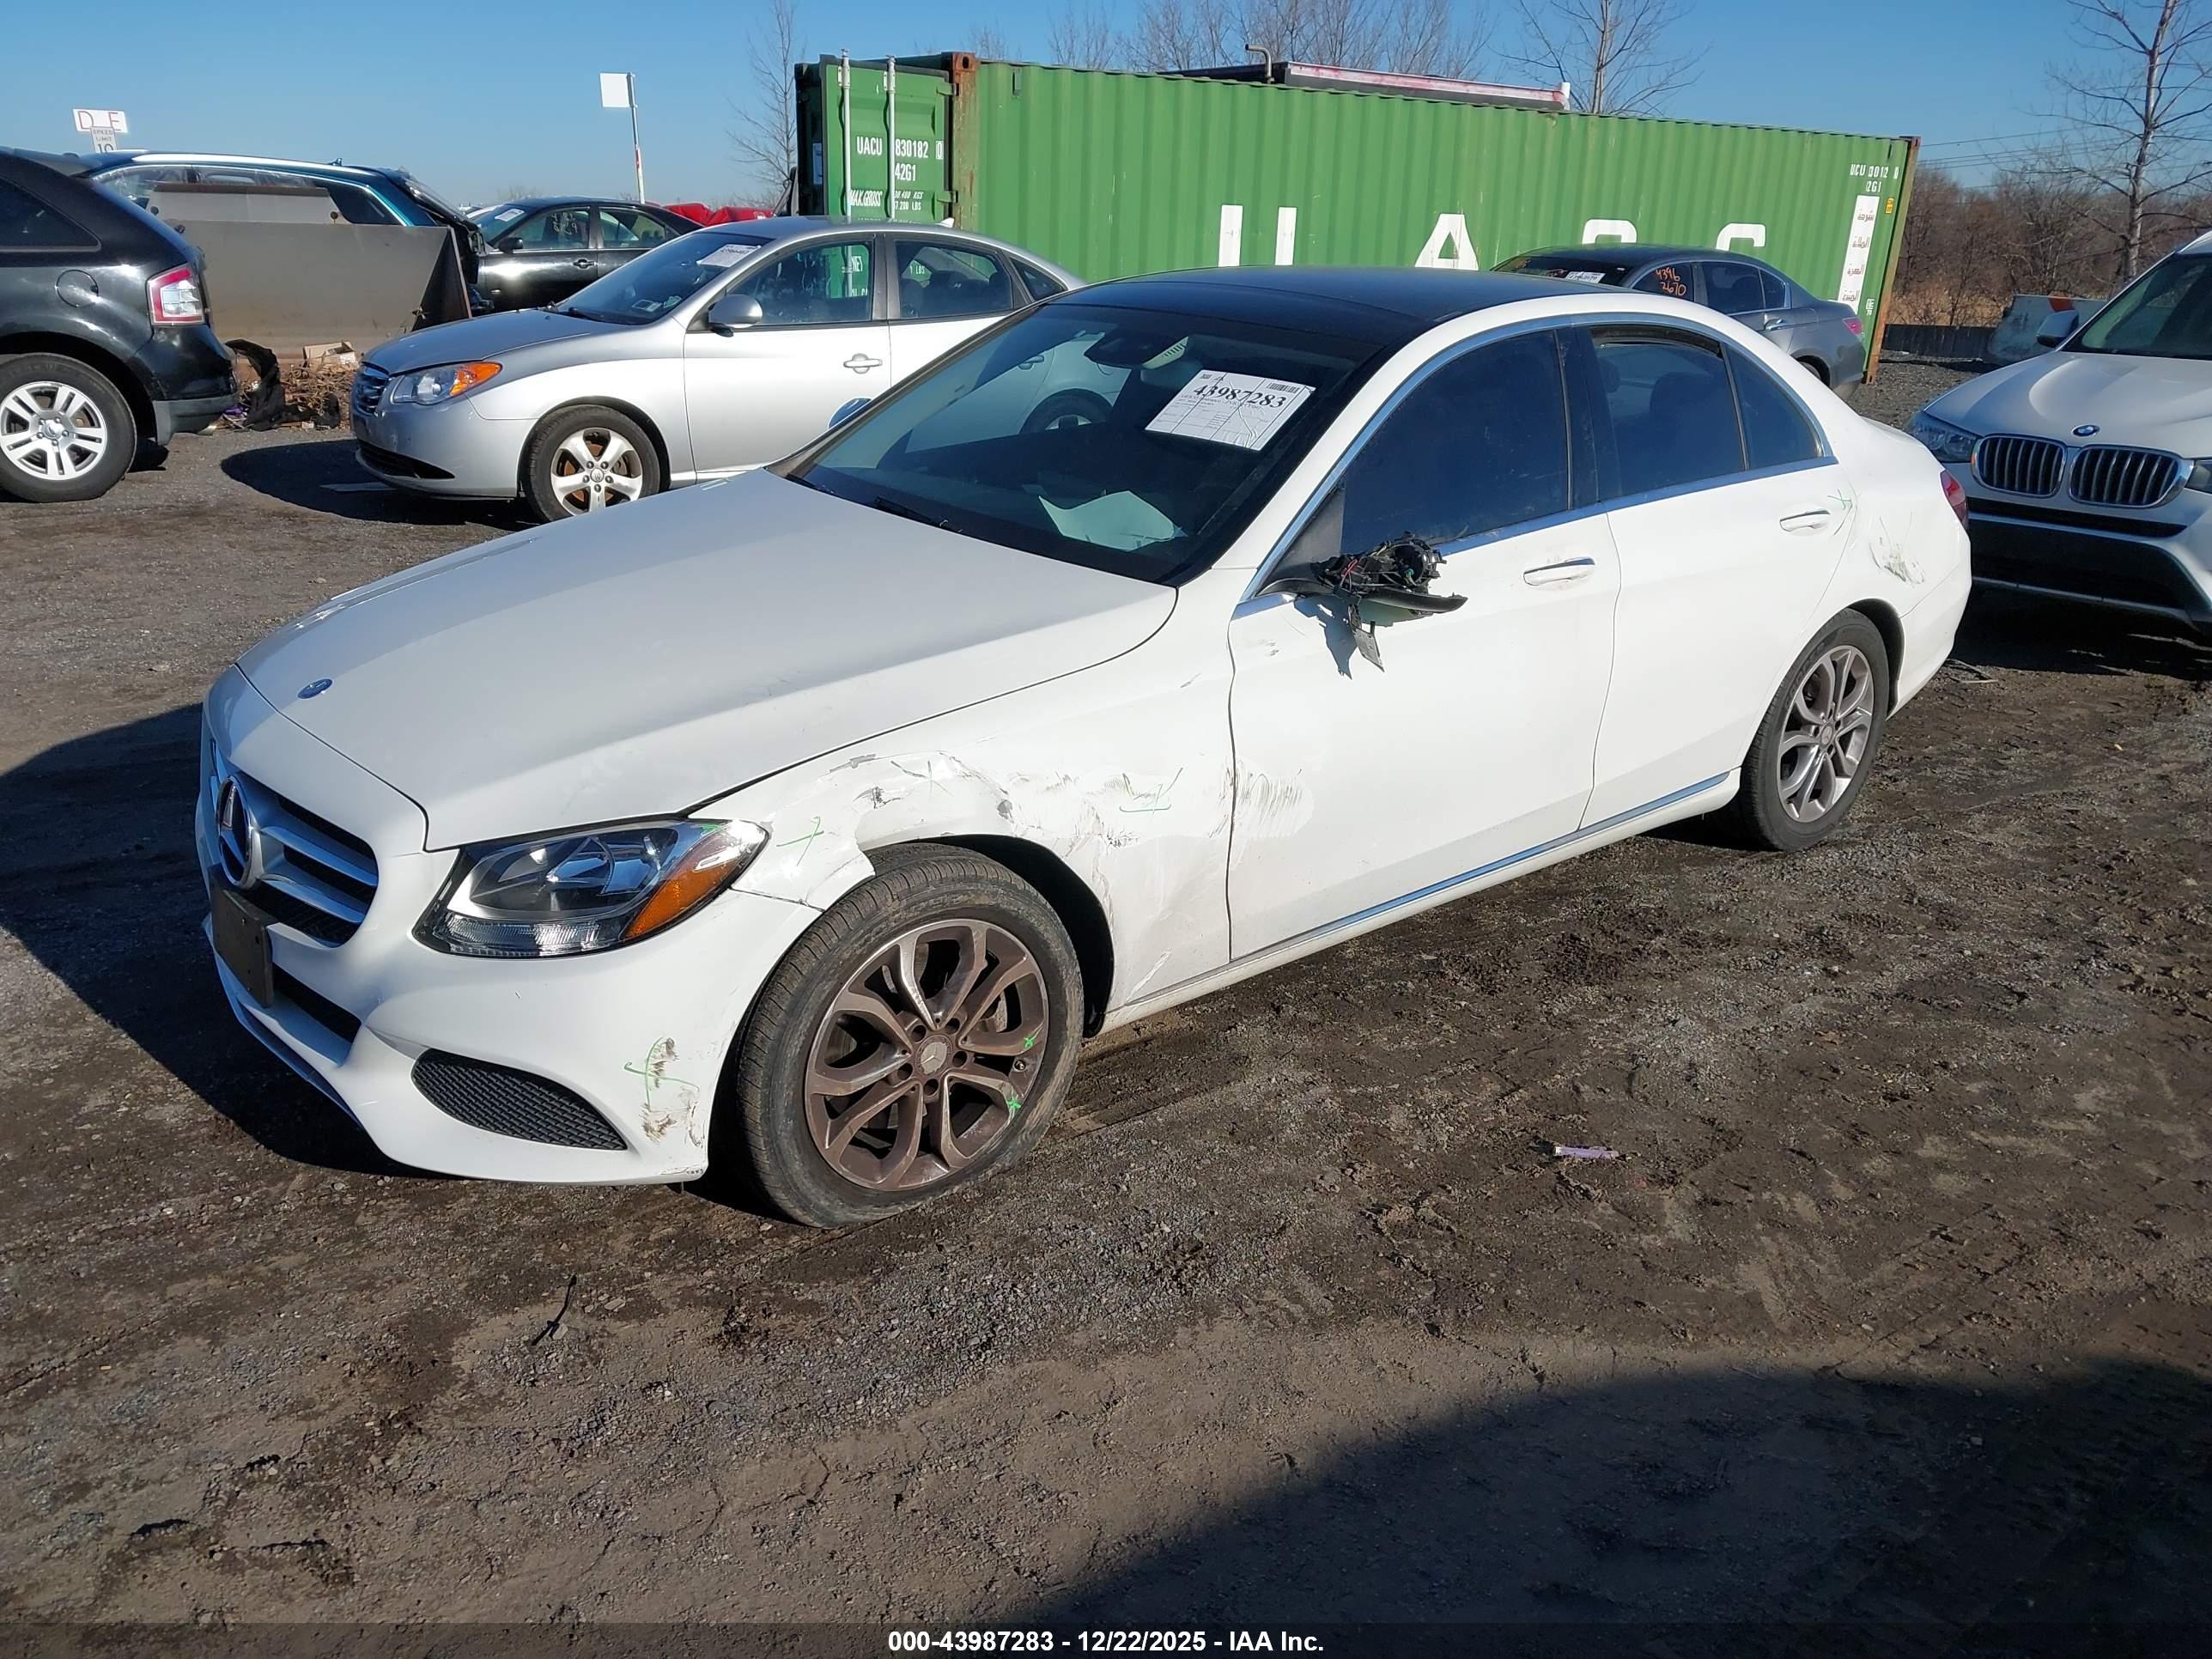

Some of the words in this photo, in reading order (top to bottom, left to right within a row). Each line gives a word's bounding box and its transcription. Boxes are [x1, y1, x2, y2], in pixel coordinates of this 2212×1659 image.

[77, 110, 94, 130] D
[856, 136, 883, 155] UACU
[895, 138, 929, 159] 830182
[894, 162, 916, 182] 42G1
[1655, 266, 1680, 282] 4396
[1660, 281, 1686, 296] 2670
[1193, 385, 1286, 408] 43987283
